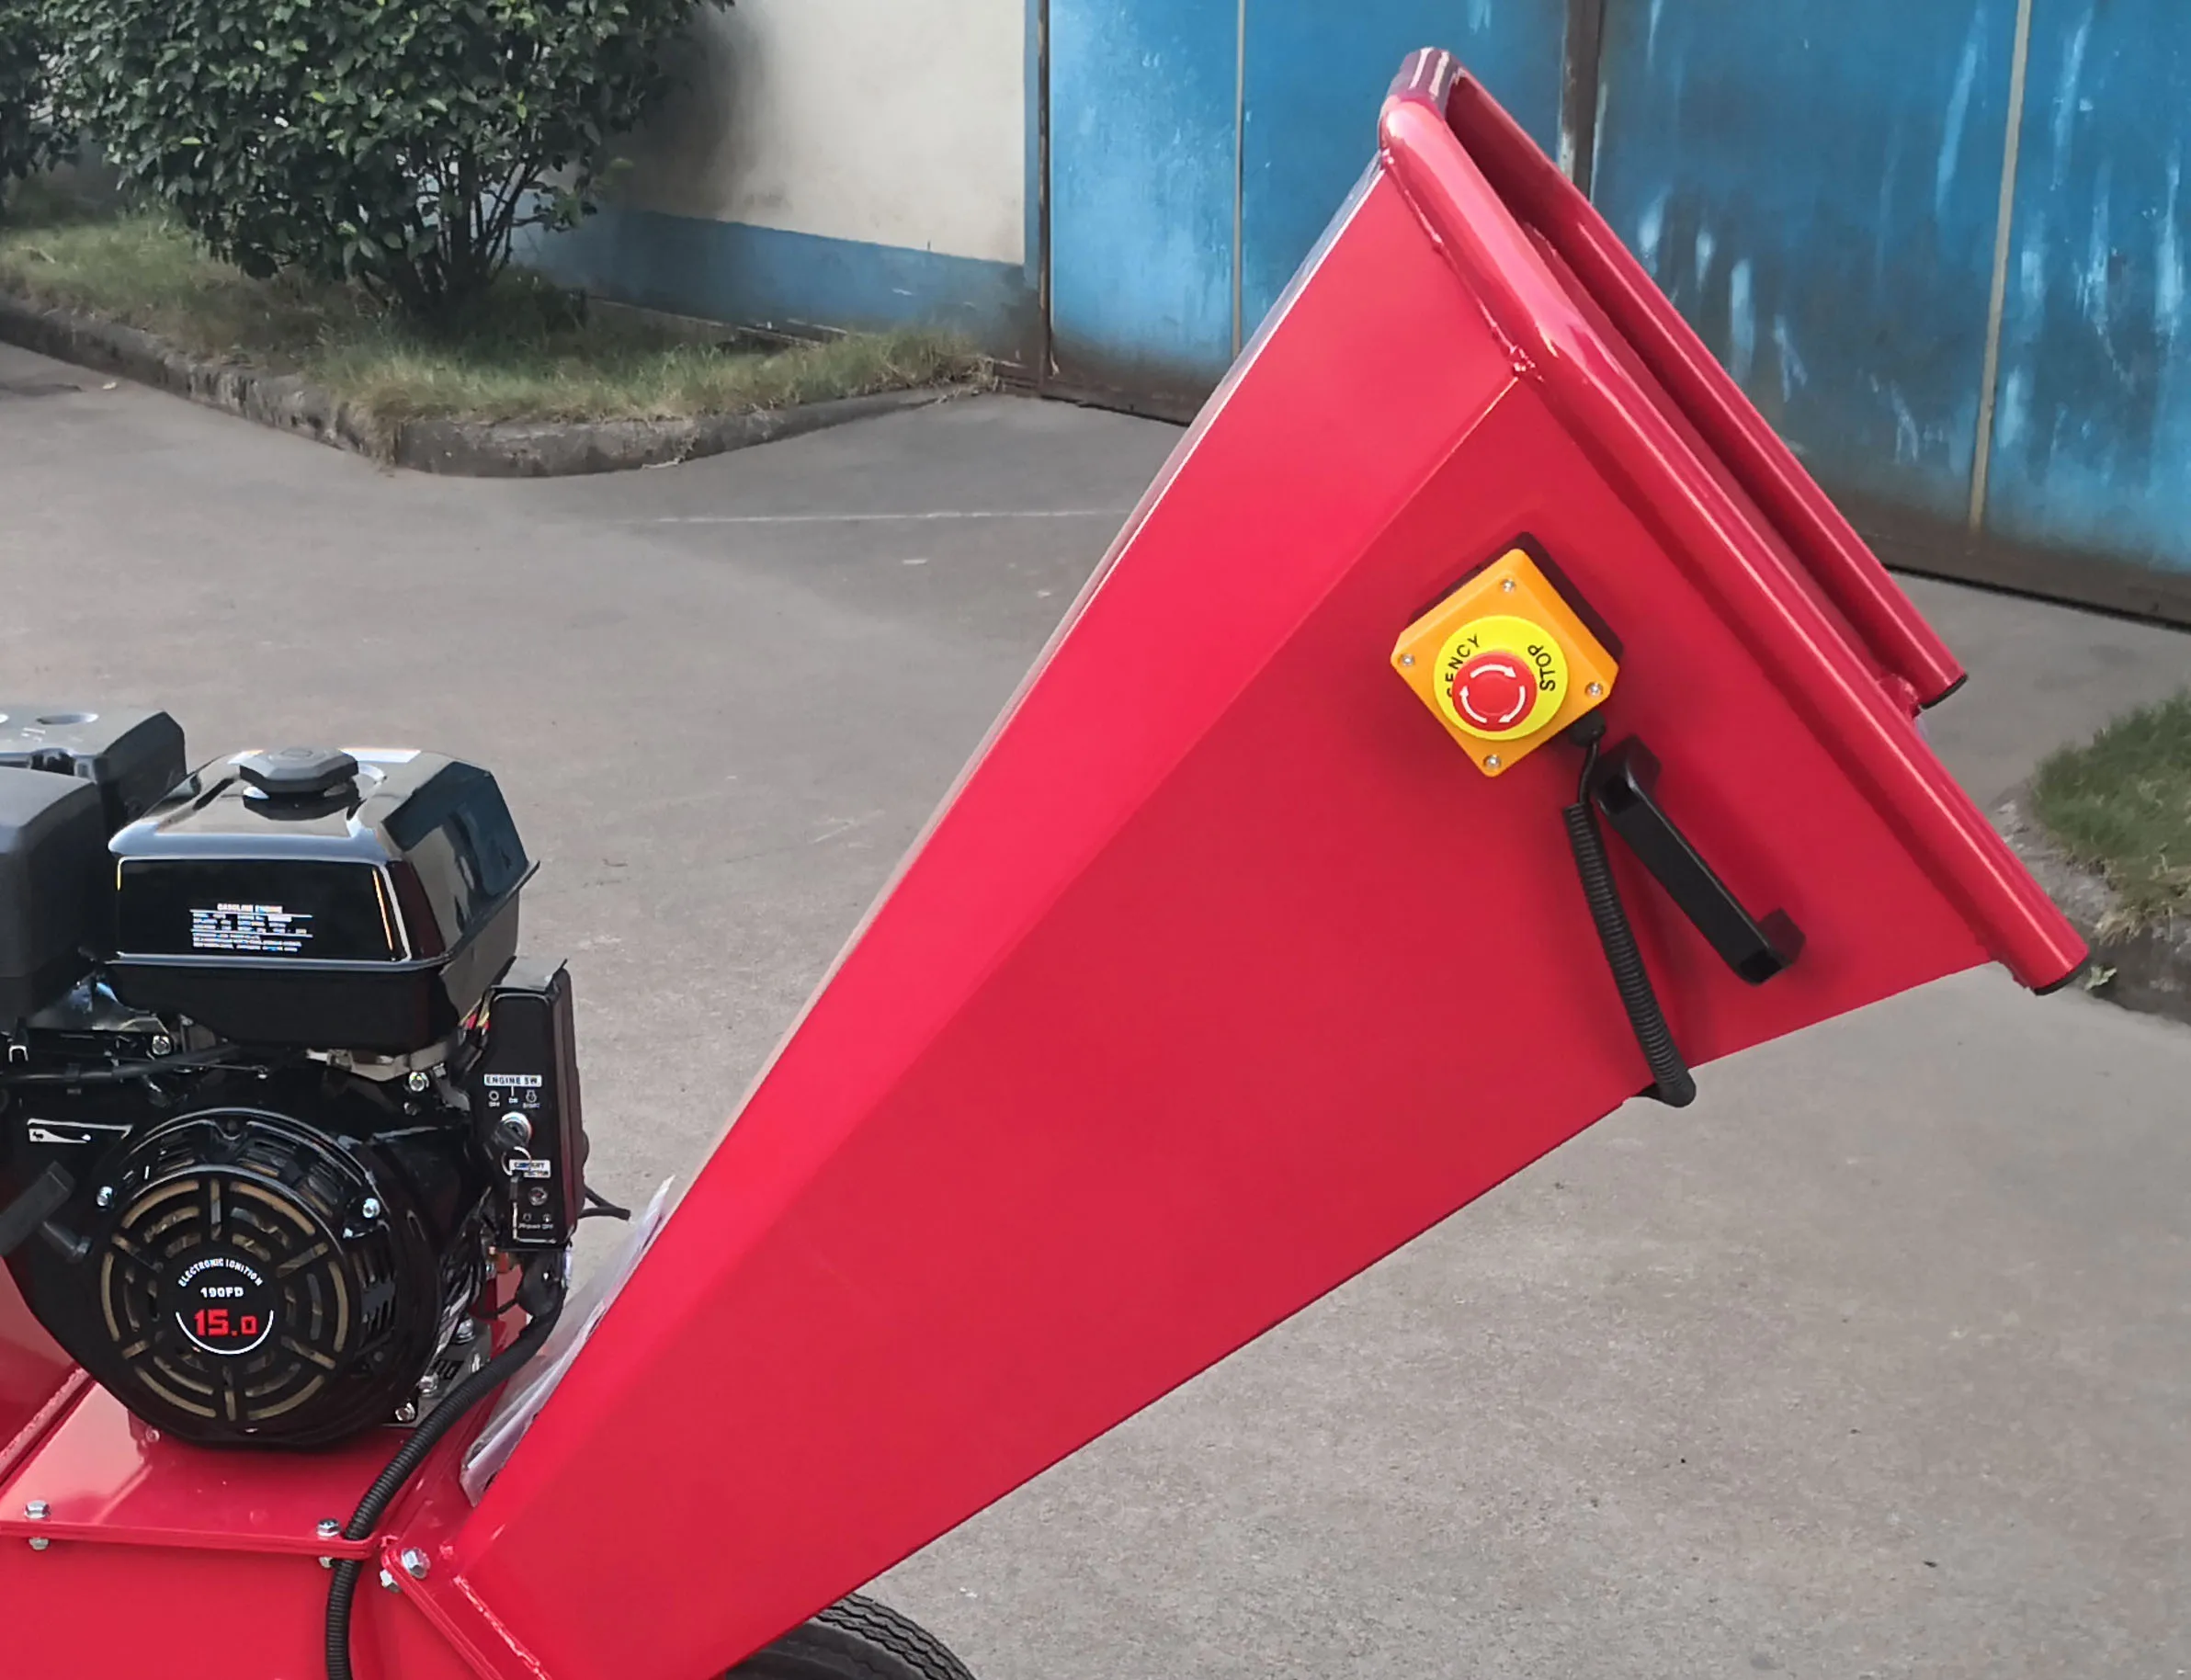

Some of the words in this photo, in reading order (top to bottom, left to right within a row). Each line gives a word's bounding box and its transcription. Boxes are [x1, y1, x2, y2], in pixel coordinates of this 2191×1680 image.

[1527, 644, 1556, 692] STOP
[486, 1075, 521, 1084] ENGINE
[178, 1257, 224, 1288] ELECTRONIC
[226, 1258, 264, 1287] IGNITION
[194, 1309, 258, 1337] 15.0
